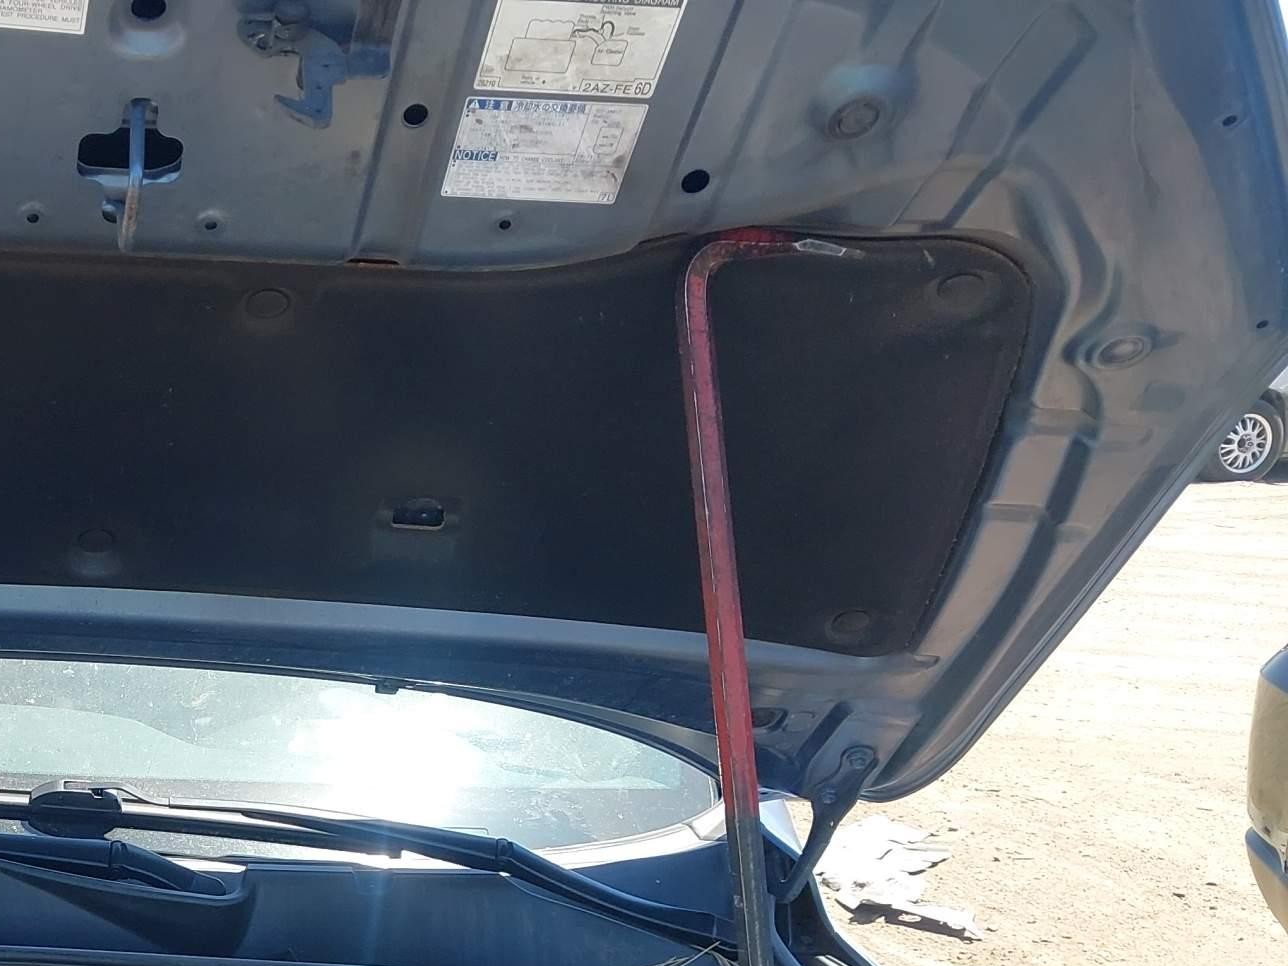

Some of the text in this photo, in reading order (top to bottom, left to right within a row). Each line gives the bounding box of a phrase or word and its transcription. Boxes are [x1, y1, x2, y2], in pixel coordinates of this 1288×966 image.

[582, 81, 652, 96] 2AZ-FE 6D
[454, 150, 497, 161] NOTICE
